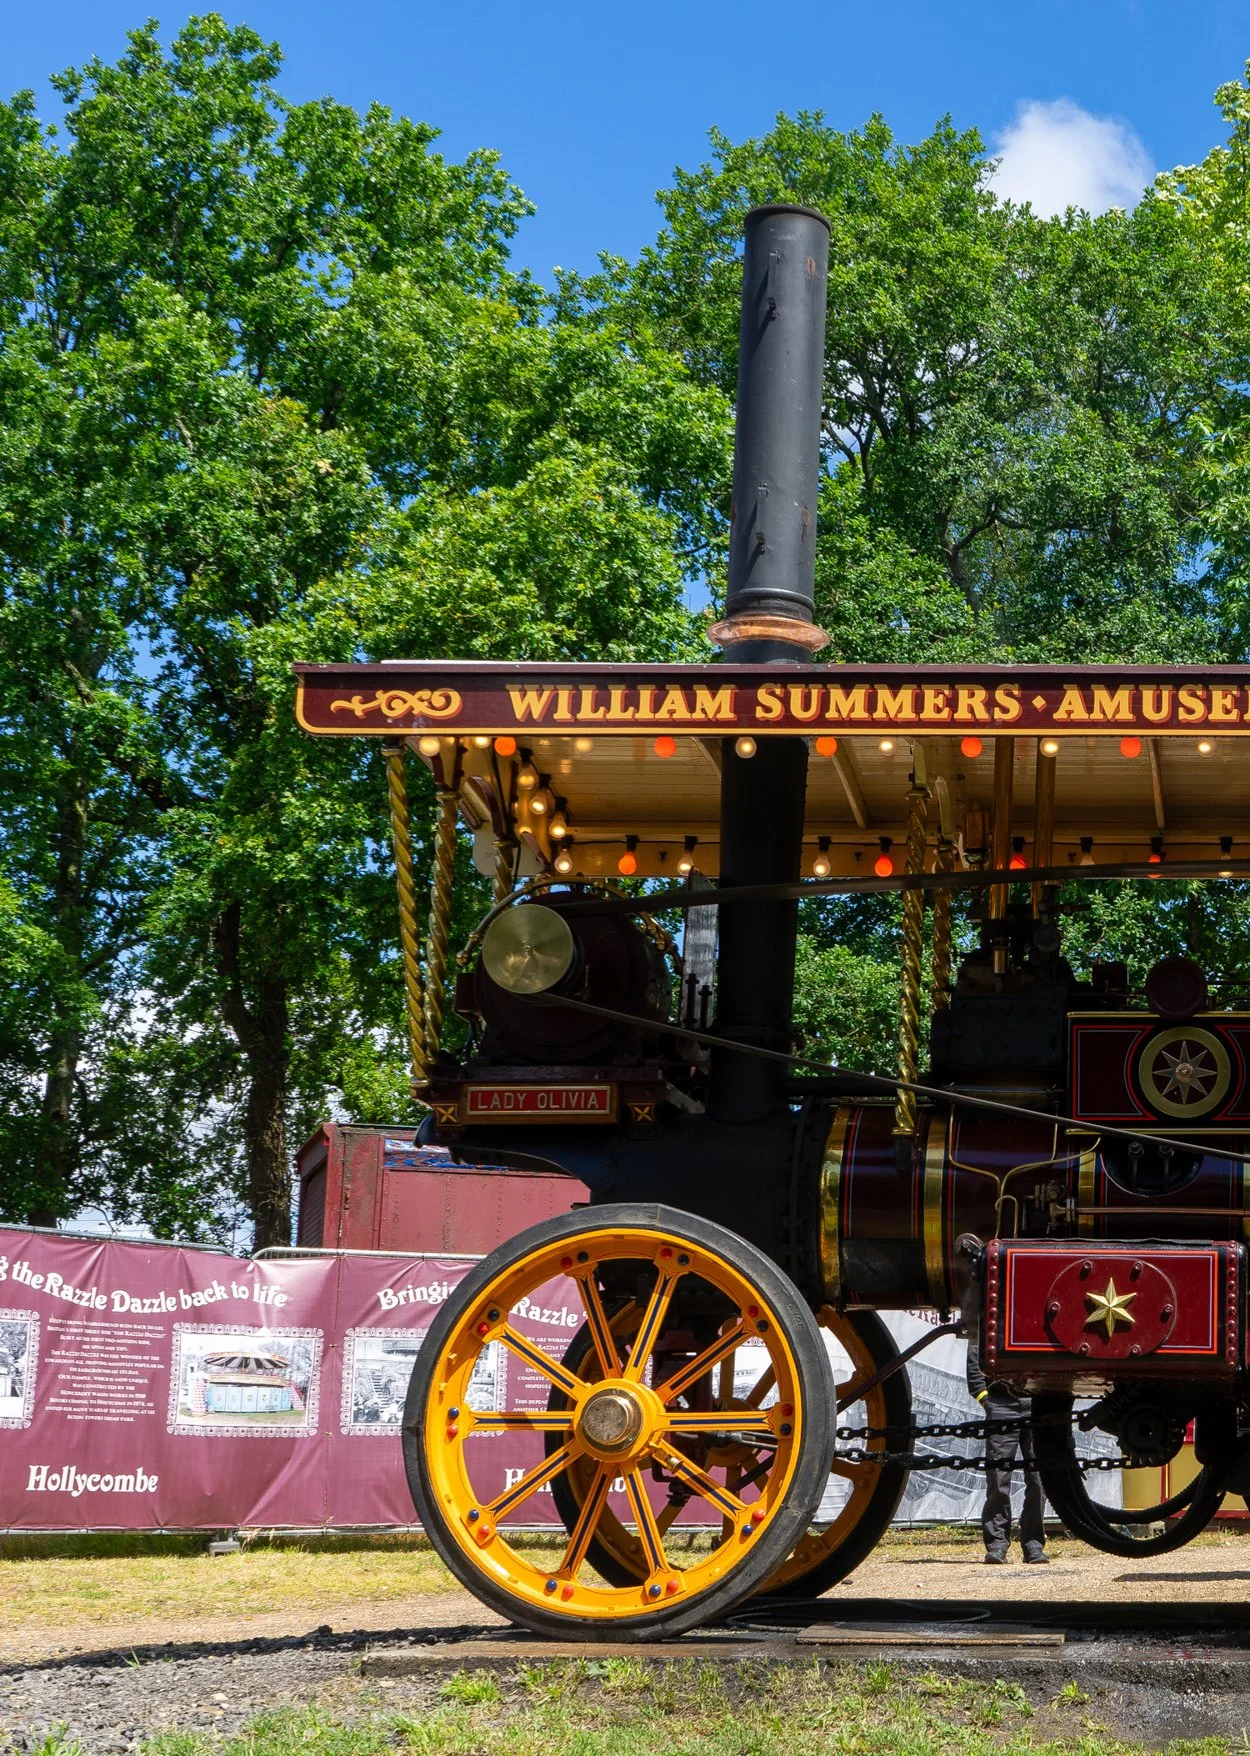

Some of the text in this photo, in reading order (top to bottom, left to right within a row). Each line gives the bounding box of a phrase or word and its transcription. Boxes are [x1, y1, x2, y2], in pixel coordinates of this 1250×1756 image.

[508, 683, 735, 722] WILLIAM
[755, 683, 1024, 723] SUMMERS
[477, 1092, 599, 1109] LADY OLIVIA
[12, 1260, 44, 1289] the
[42, 1272, 108, 1310] Razzle
[111, 1290, 177, 1313] Dazzle
[179, 1280, 228, 1310] back
[231, 1281, 250, 1301] to
[253, 1283, 289, 1308] life
[377, 1281, 578, 1327] Bringi Razzle
[26, 1465, 159, 1497] Hollycombe
